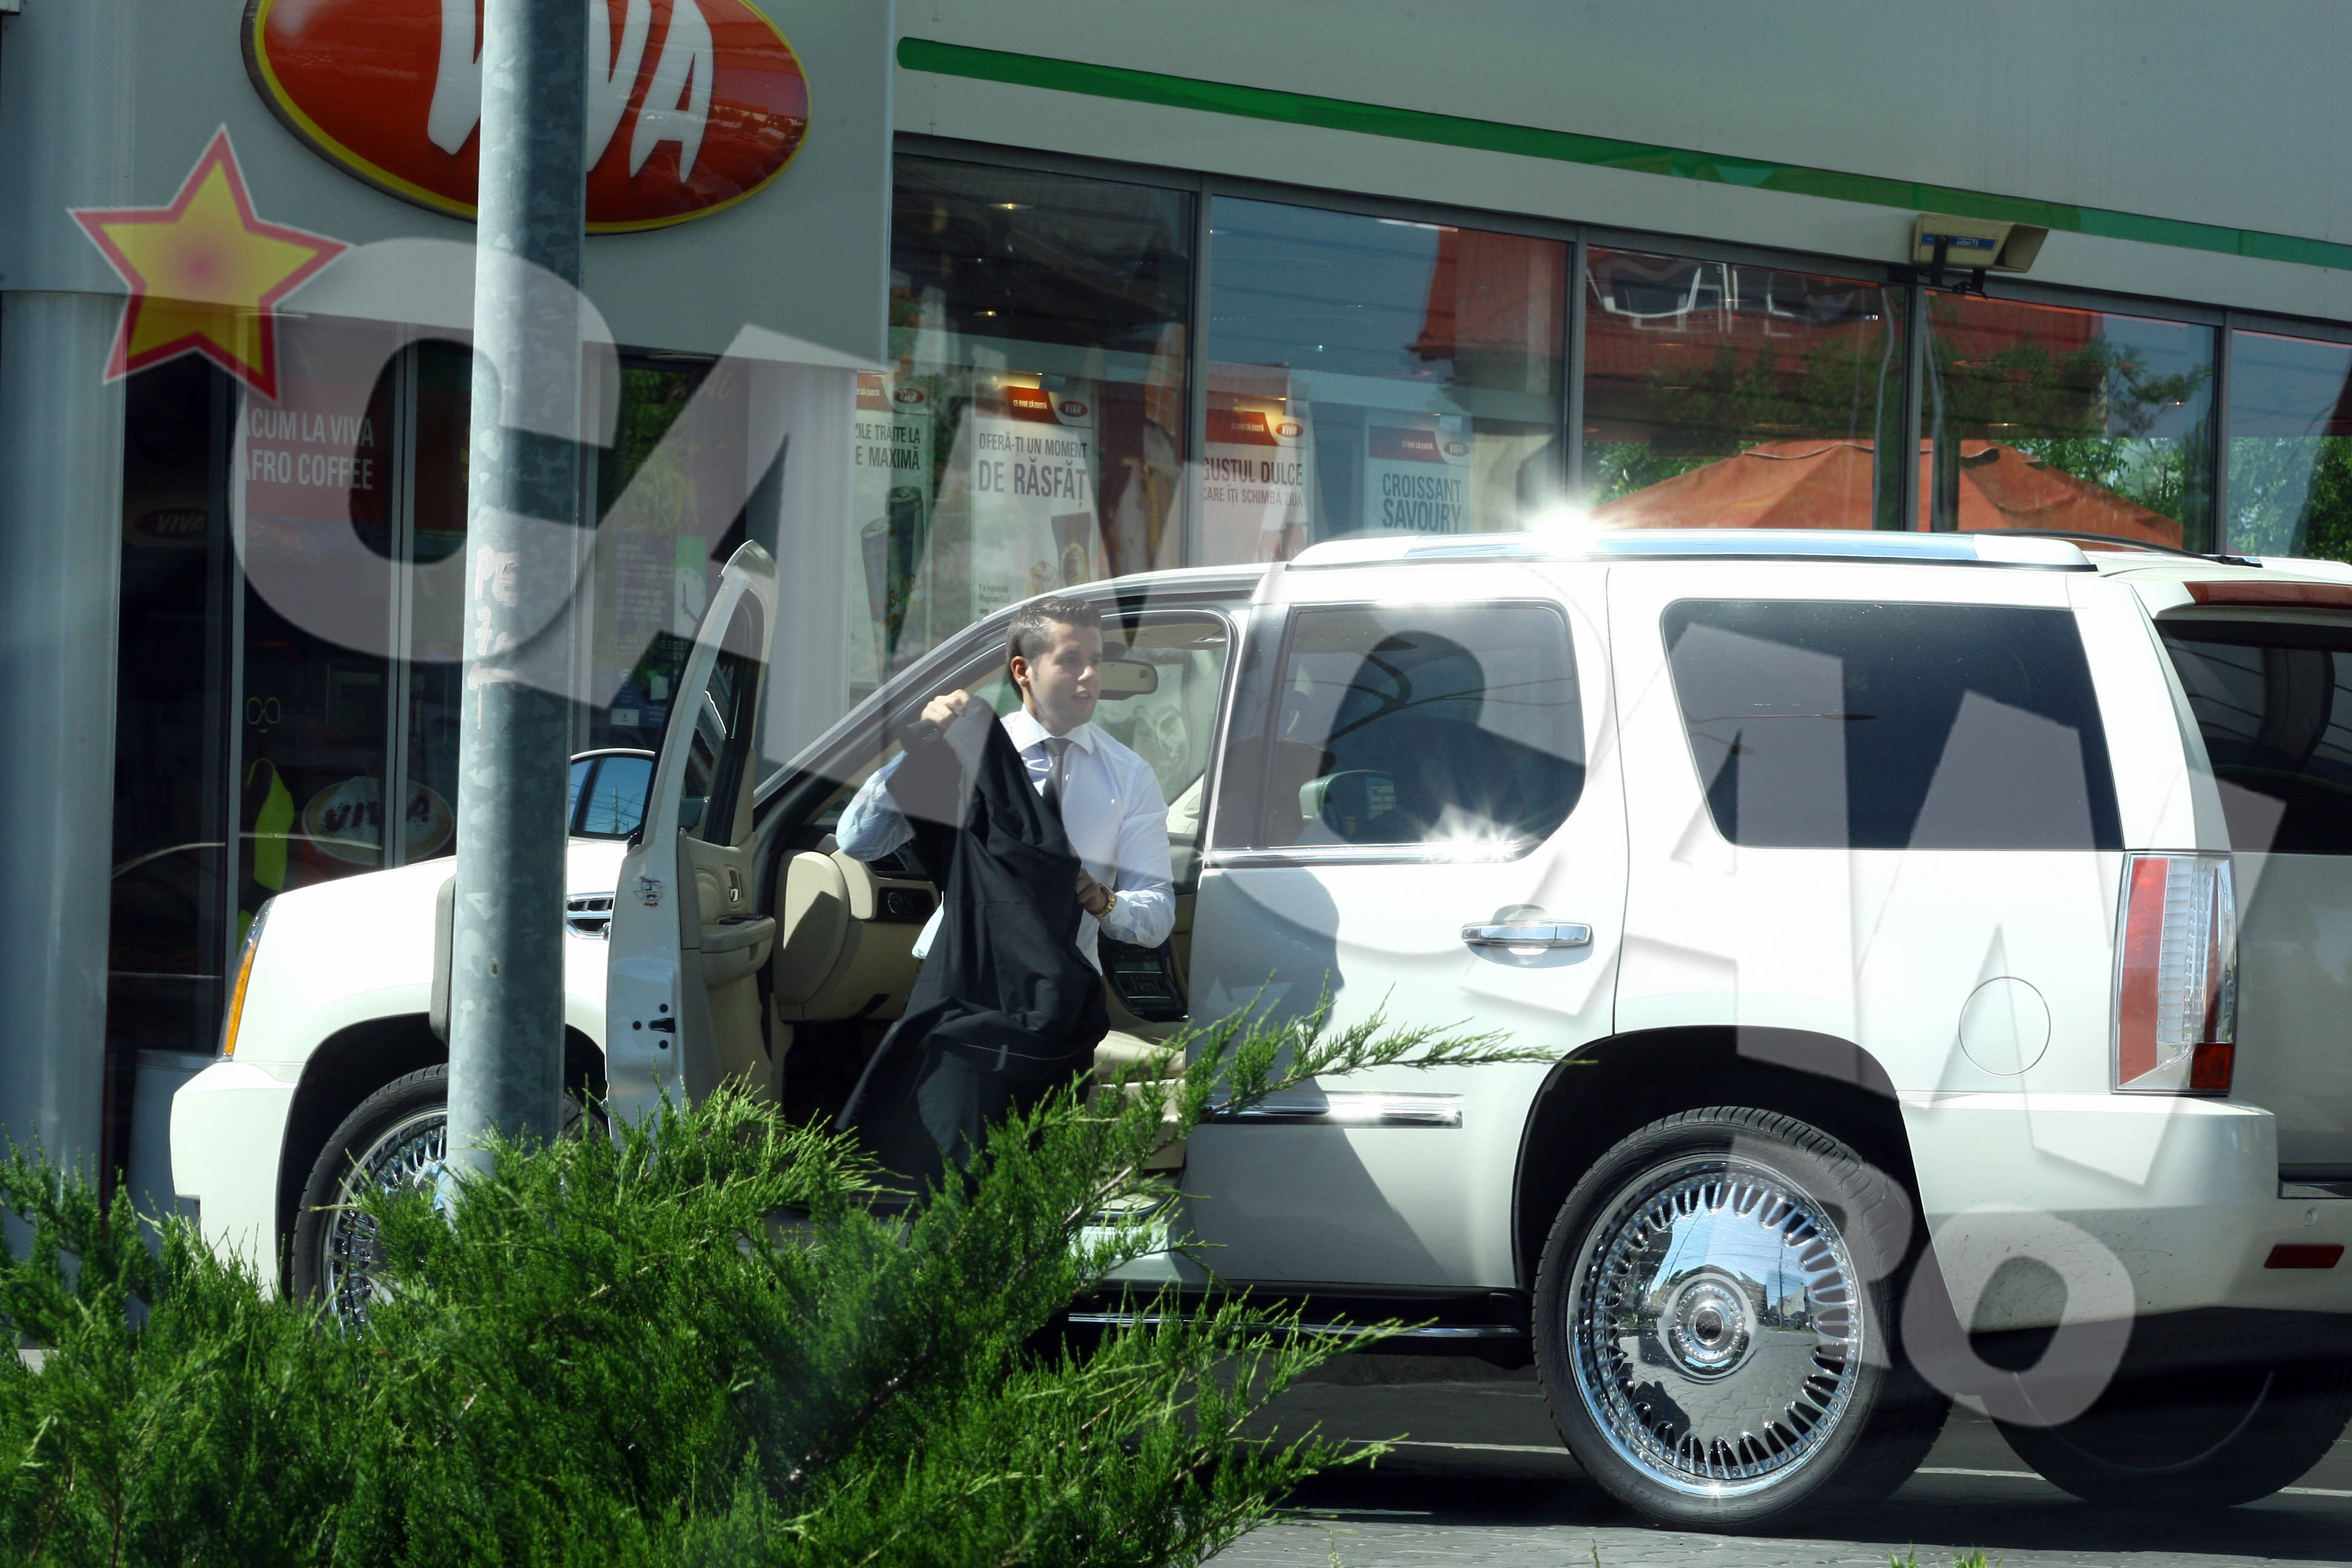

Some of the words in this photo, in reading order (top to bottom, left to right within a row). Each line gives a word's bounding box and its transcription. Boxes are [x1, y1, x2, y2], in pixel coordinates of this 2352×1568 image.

[428, 0, 713, 185] VVA
[1065, 403, 1082, 414] VIVA
[302, 412, 327, 444] LA
[330, 414, 374, 448] VIVA
[875, 422, 906, 443] TRĂITE
[909, 427, 920, 443] LA
[1282, 425, 1297, 435] VIVA
[869, 446, 920, 470] MAXIMĂ
[1027, 438, 1041, 455] UN
[1045, 439, 1087, 459] MOMENT
[298, 453, 374, 490] COFFEE
[978, 460, 1004, 492] DE
[1261, 461, 1302, 486] DULCE
[1383, 473, 1462, 502] CROISSANT
[1383, 498, 1462, 533] SAVOURY
